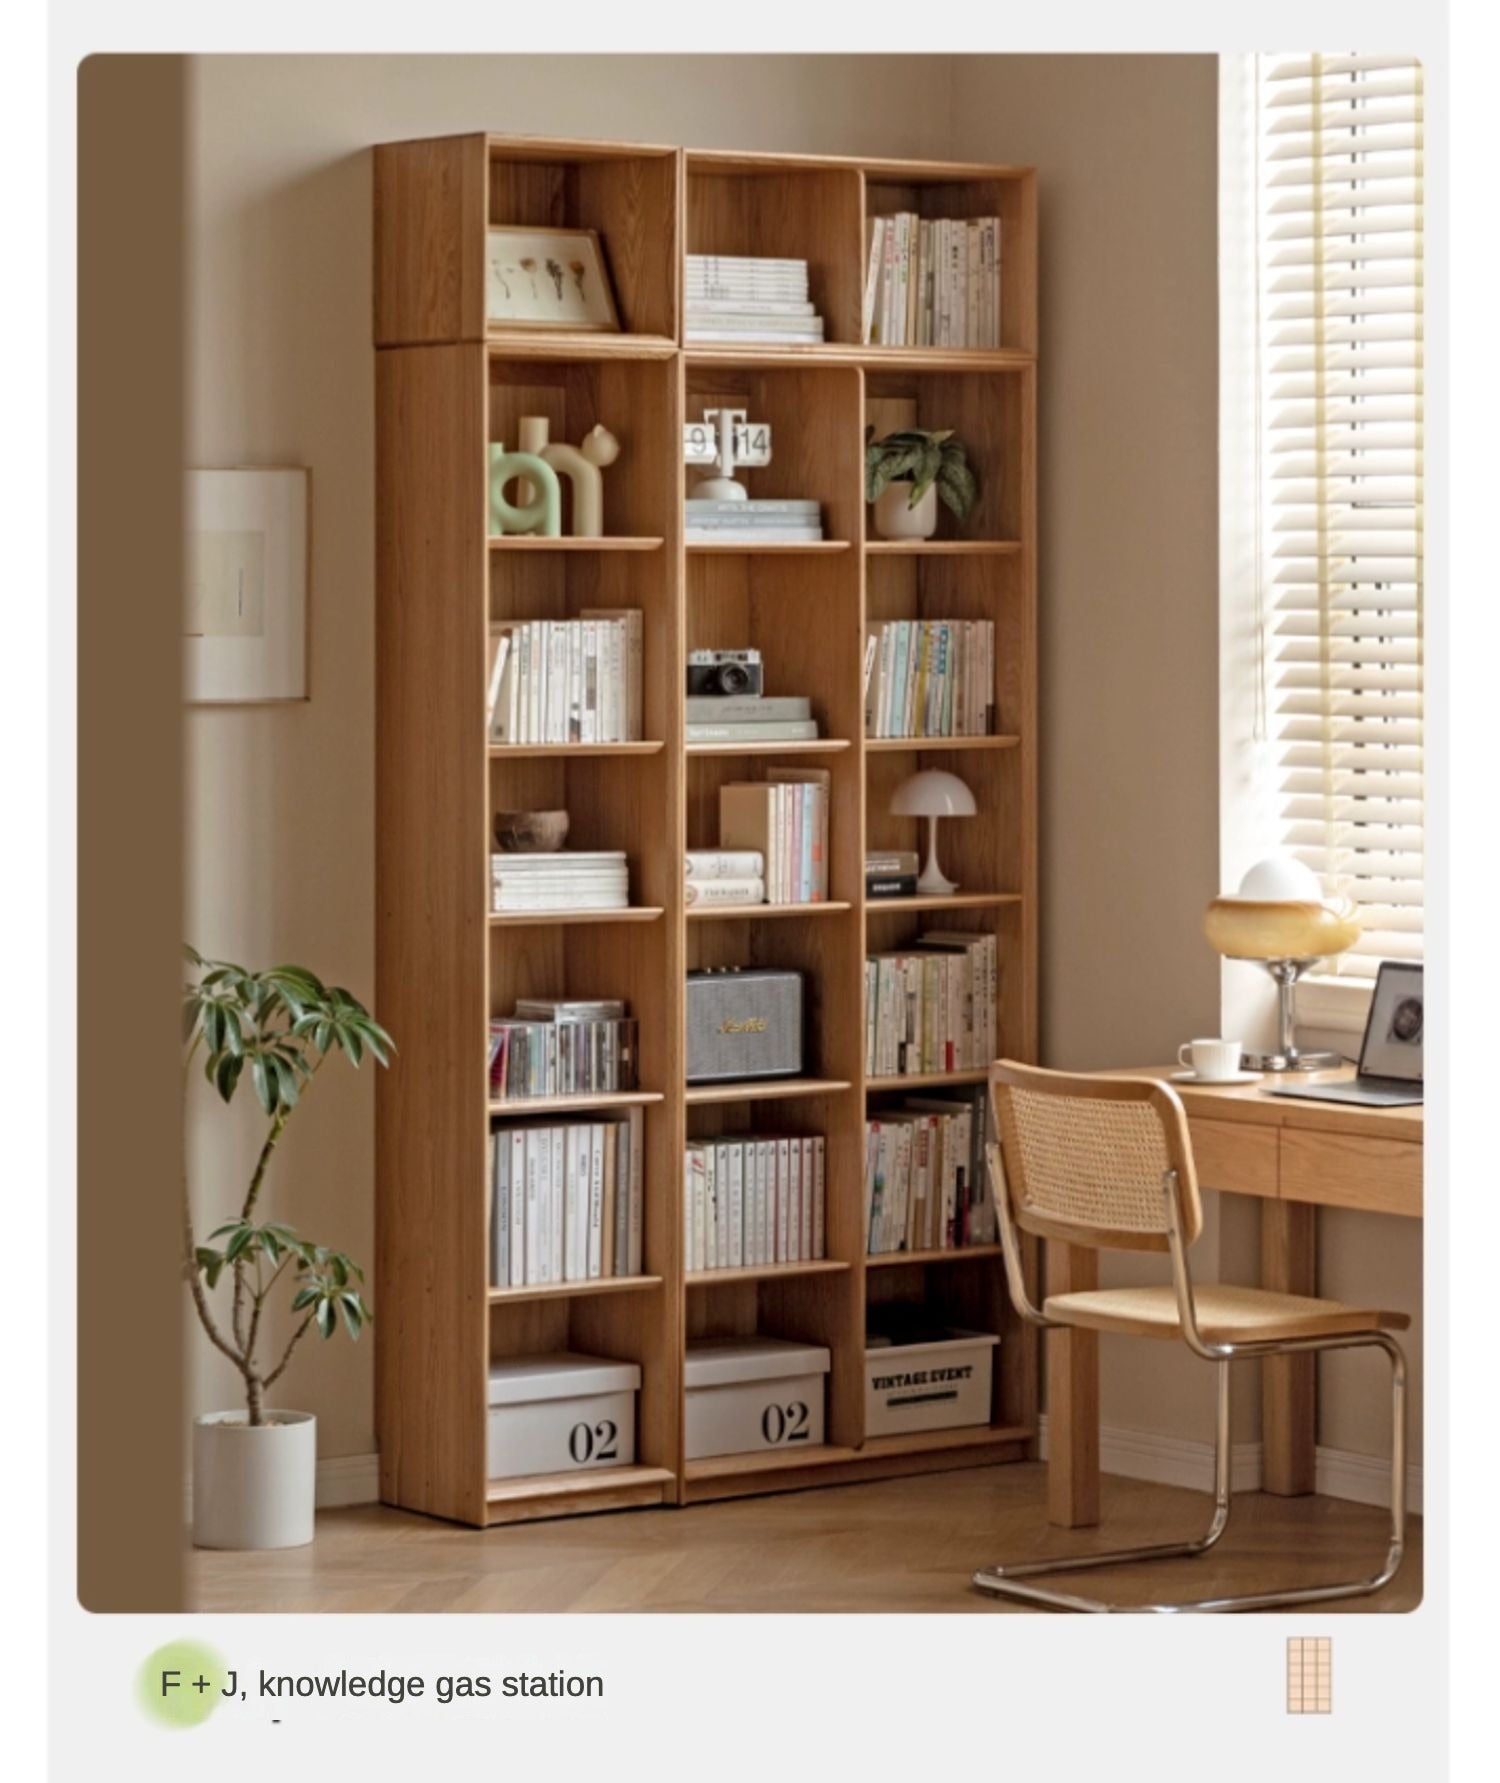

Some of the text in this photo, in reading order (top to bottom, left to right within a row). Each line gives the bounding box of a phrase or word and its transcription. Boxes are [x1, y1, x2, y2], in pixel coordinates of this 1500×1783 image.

[740, 427, 767, 455] 14
[871, 1371, 927, 1391] VINTAGE
[929, 1365, 973, 1384] EVENT
[762, 1401, 809, 1444] 02
[569, 1420, 618, 1464] 02
